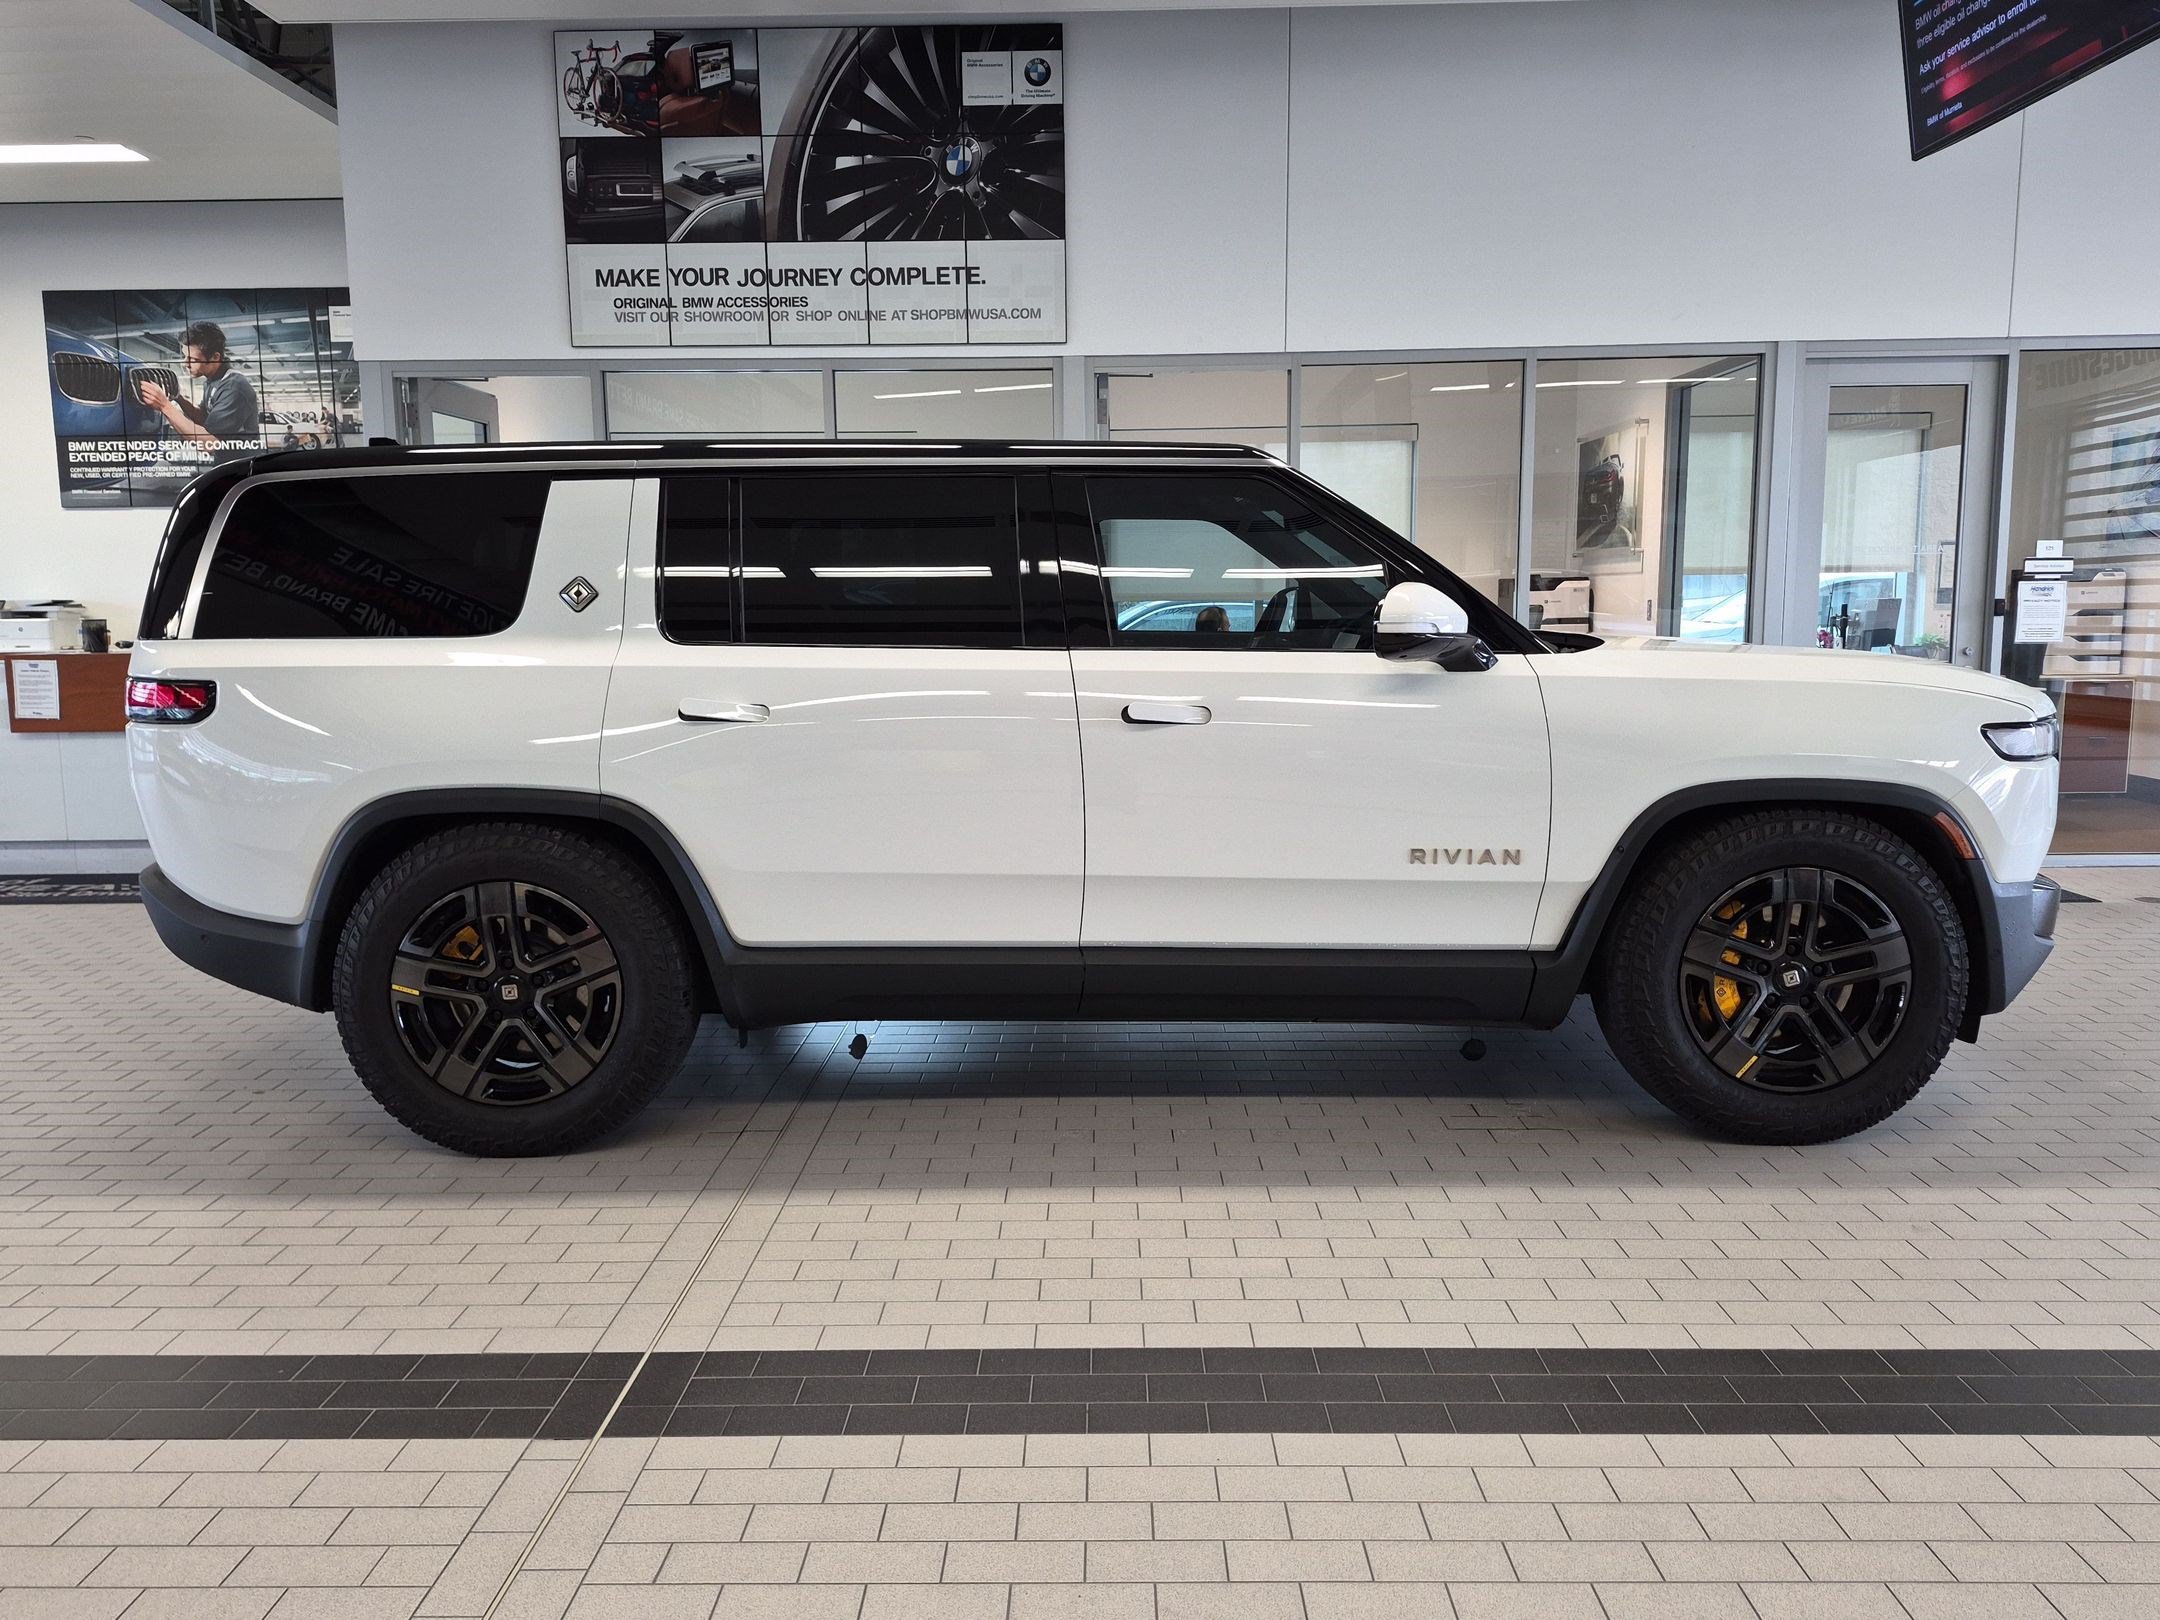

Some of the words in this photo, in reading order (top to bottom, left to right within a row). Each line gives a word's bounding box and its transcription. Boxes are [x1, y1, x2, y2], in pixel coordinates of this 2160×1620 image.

[1915, 10, 1932, 30] BMW
[1932, 4, 1941, 17] oil
[1916, 32, 1933, 48] three
[1933, 16, 1955, 37] eligible
[1956, 8, 1965, 22] oil
[1919, 60, 1931, 75] Ask
[1931, 52, 1946, 70] your
[1946, 36, 1970, 58] service
[1971, 19, 1997, 42] advisor
[1997, 14, 2006, 25] to
[2007, 0, 2029, 20] enroll
[595, 268, 660, 287] MAKE
[669, 267, 729, 287] YOUR
[737, 268, 843, 287] JOURNEY
[850, 266, 986, 286] COMPLETE.
[613, 297, 677, 309] ORIGINAL
[682, 297, 714, 308] BMW
[716, 296, 808, 308] ACCESSORIES
[614, 311, 646, 323] VISIT
[649, 311, 679, 322] OUR
[684, 310, 764, 322] SHOWROOM
[771, 310, 789, 321] OR
[796, 310, 832, 321] SHOP
[838, 310, 886, 321] ONLINE
[891, 310, 907, 321] AT
[911, 308, 1041, 320] SHOPBMWUSA.COM
[68, 441, 95, 451] BMW
[97, 441, 157, 451] EXTENDED
[158, 440, 204, 450] SERVICE
[205, 440, 267, 450] CONTRACT.
[69, 452, 127, 462] EXTENDED
[128, 451, 164, 461] PEACE
[165, 451, 183, 461] OF
[1409, 848, 1521, 866] RIVIAN
